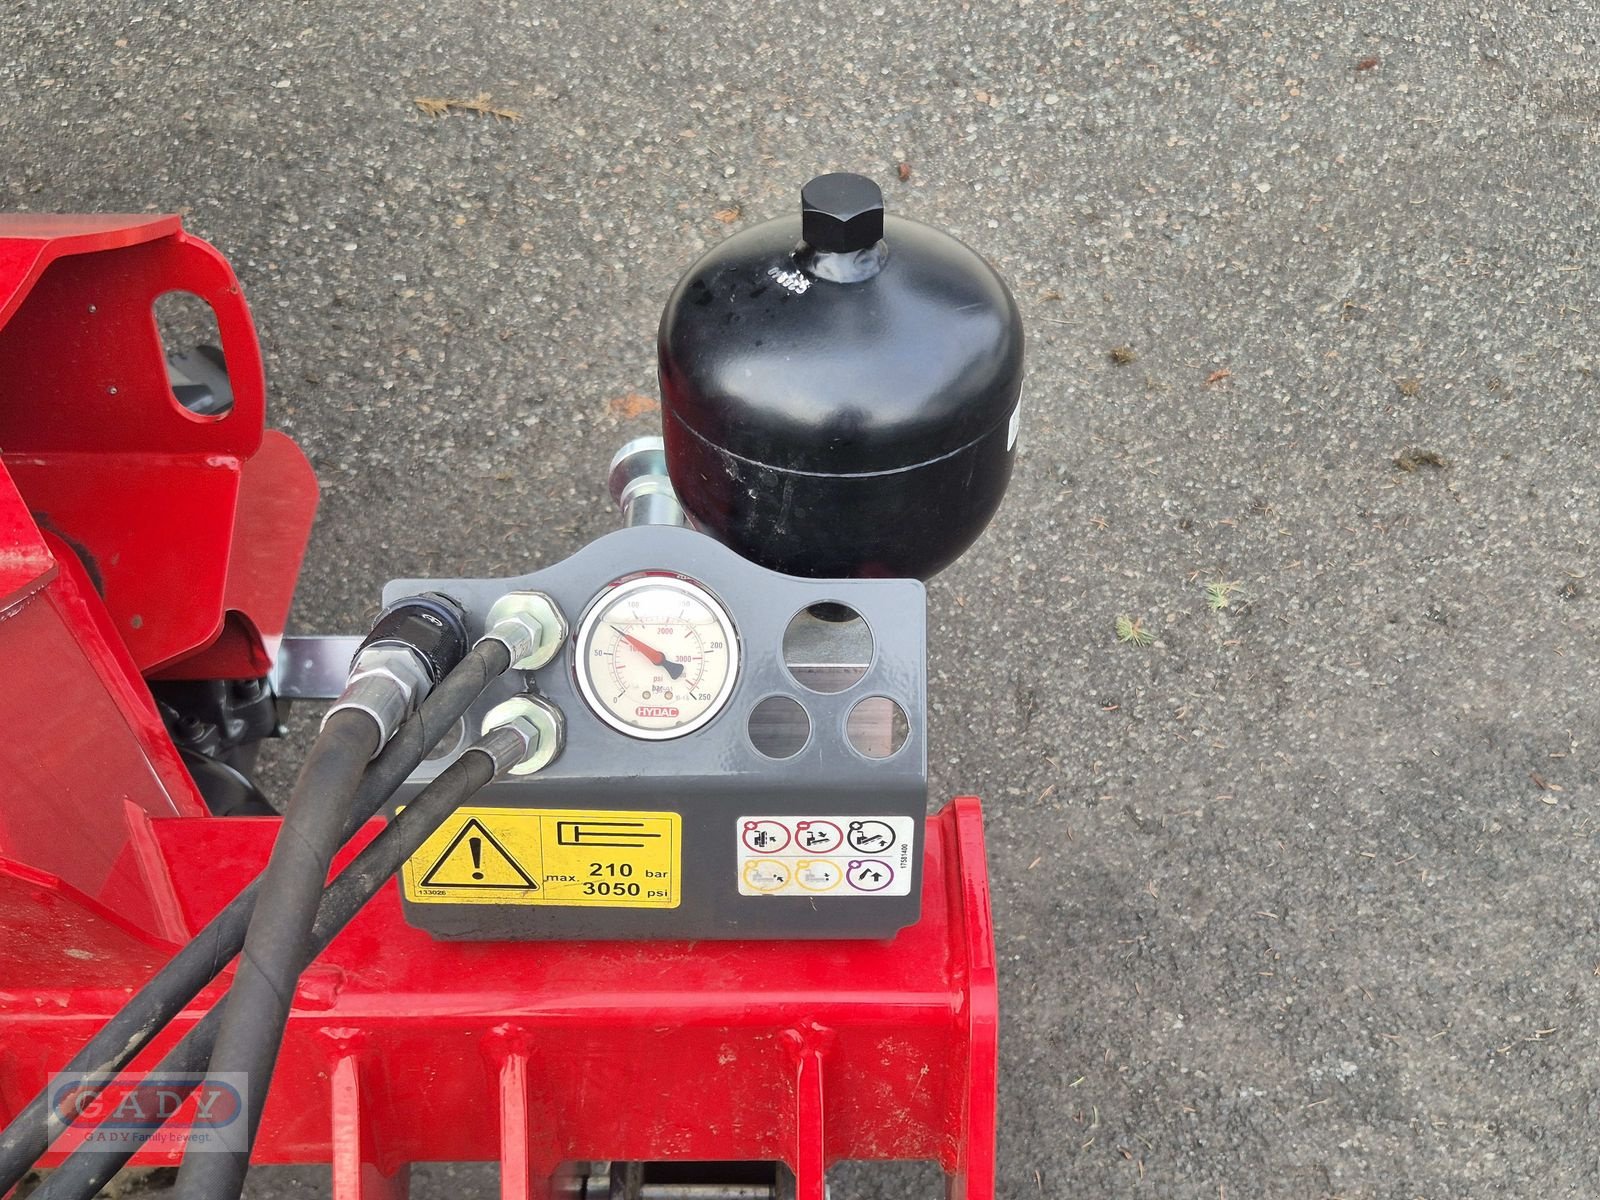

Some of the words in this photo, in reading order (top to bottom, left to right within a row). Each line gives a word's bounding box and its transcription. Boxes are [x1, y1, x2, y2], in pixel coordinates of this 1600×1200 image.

[637, 708, 677, 717] HYDAC
[900, 843, 908, 869] 17581400
[589, 863, 633, 877] 210
[645, 870, 668, 878] bar
[583, 882, 640, 896] 3050
[647, 889, 668, 897] psi
